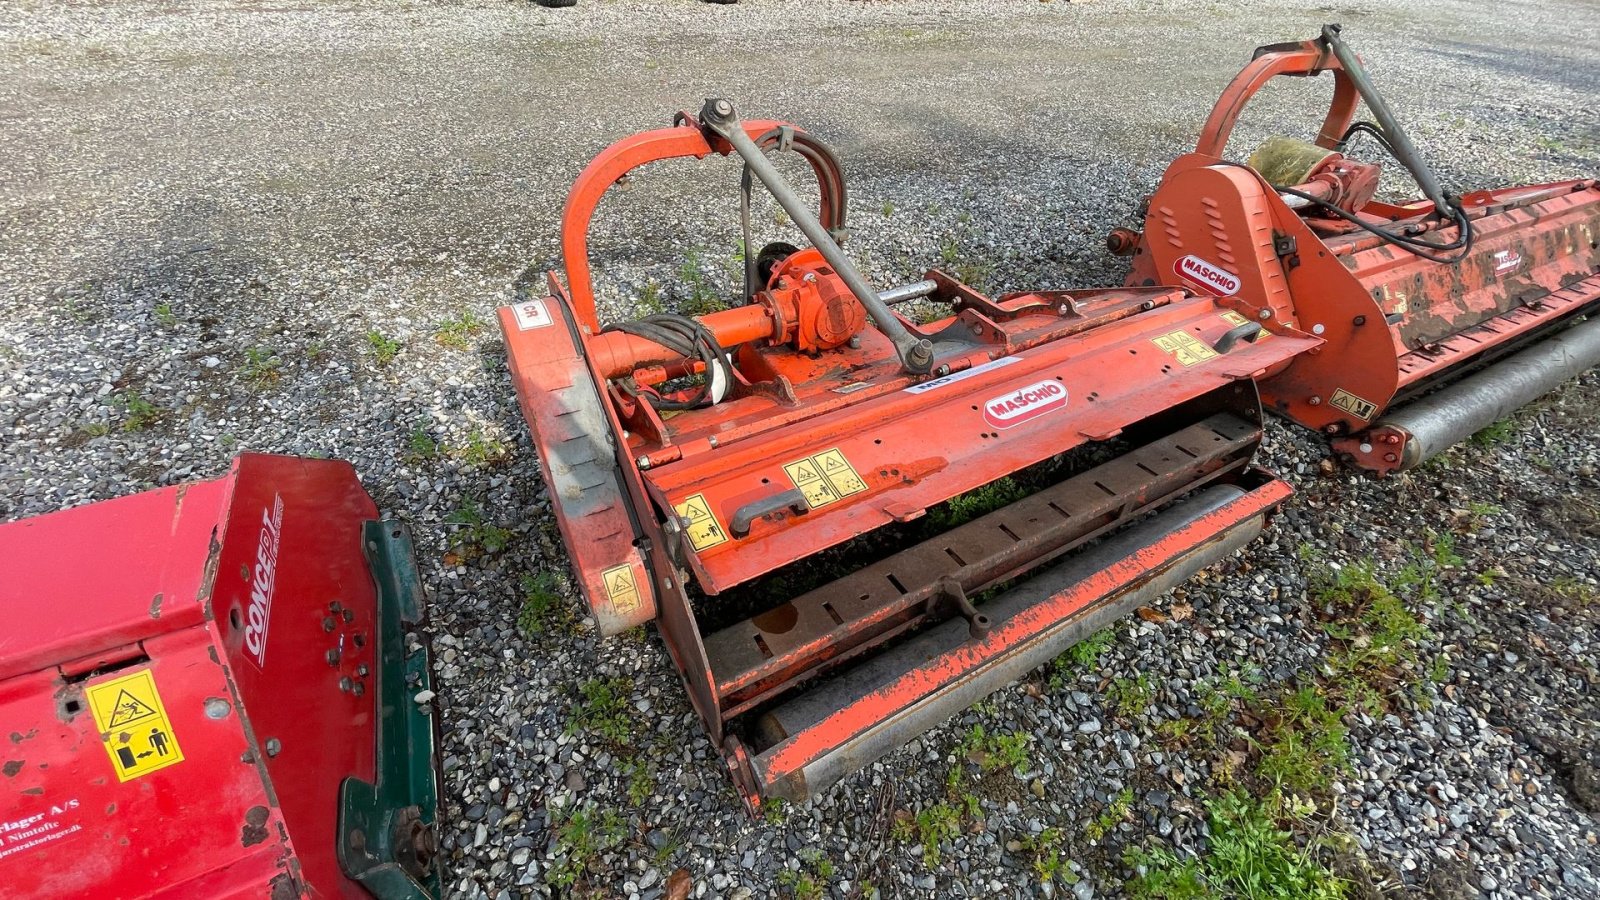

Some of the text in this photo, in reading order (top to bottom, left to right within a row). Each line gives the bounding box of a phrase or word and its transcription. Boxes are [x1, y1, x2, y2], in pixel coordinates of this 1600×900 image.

[1183, 258, 1236, 291] MASCHIO
[990, 383, 1061, 417] MASCHIO
[245, 507, 278, 657] CONCEPT
[50, 798, 80, 816] A/S
[7, 821, 60, 843] Nimtofte
